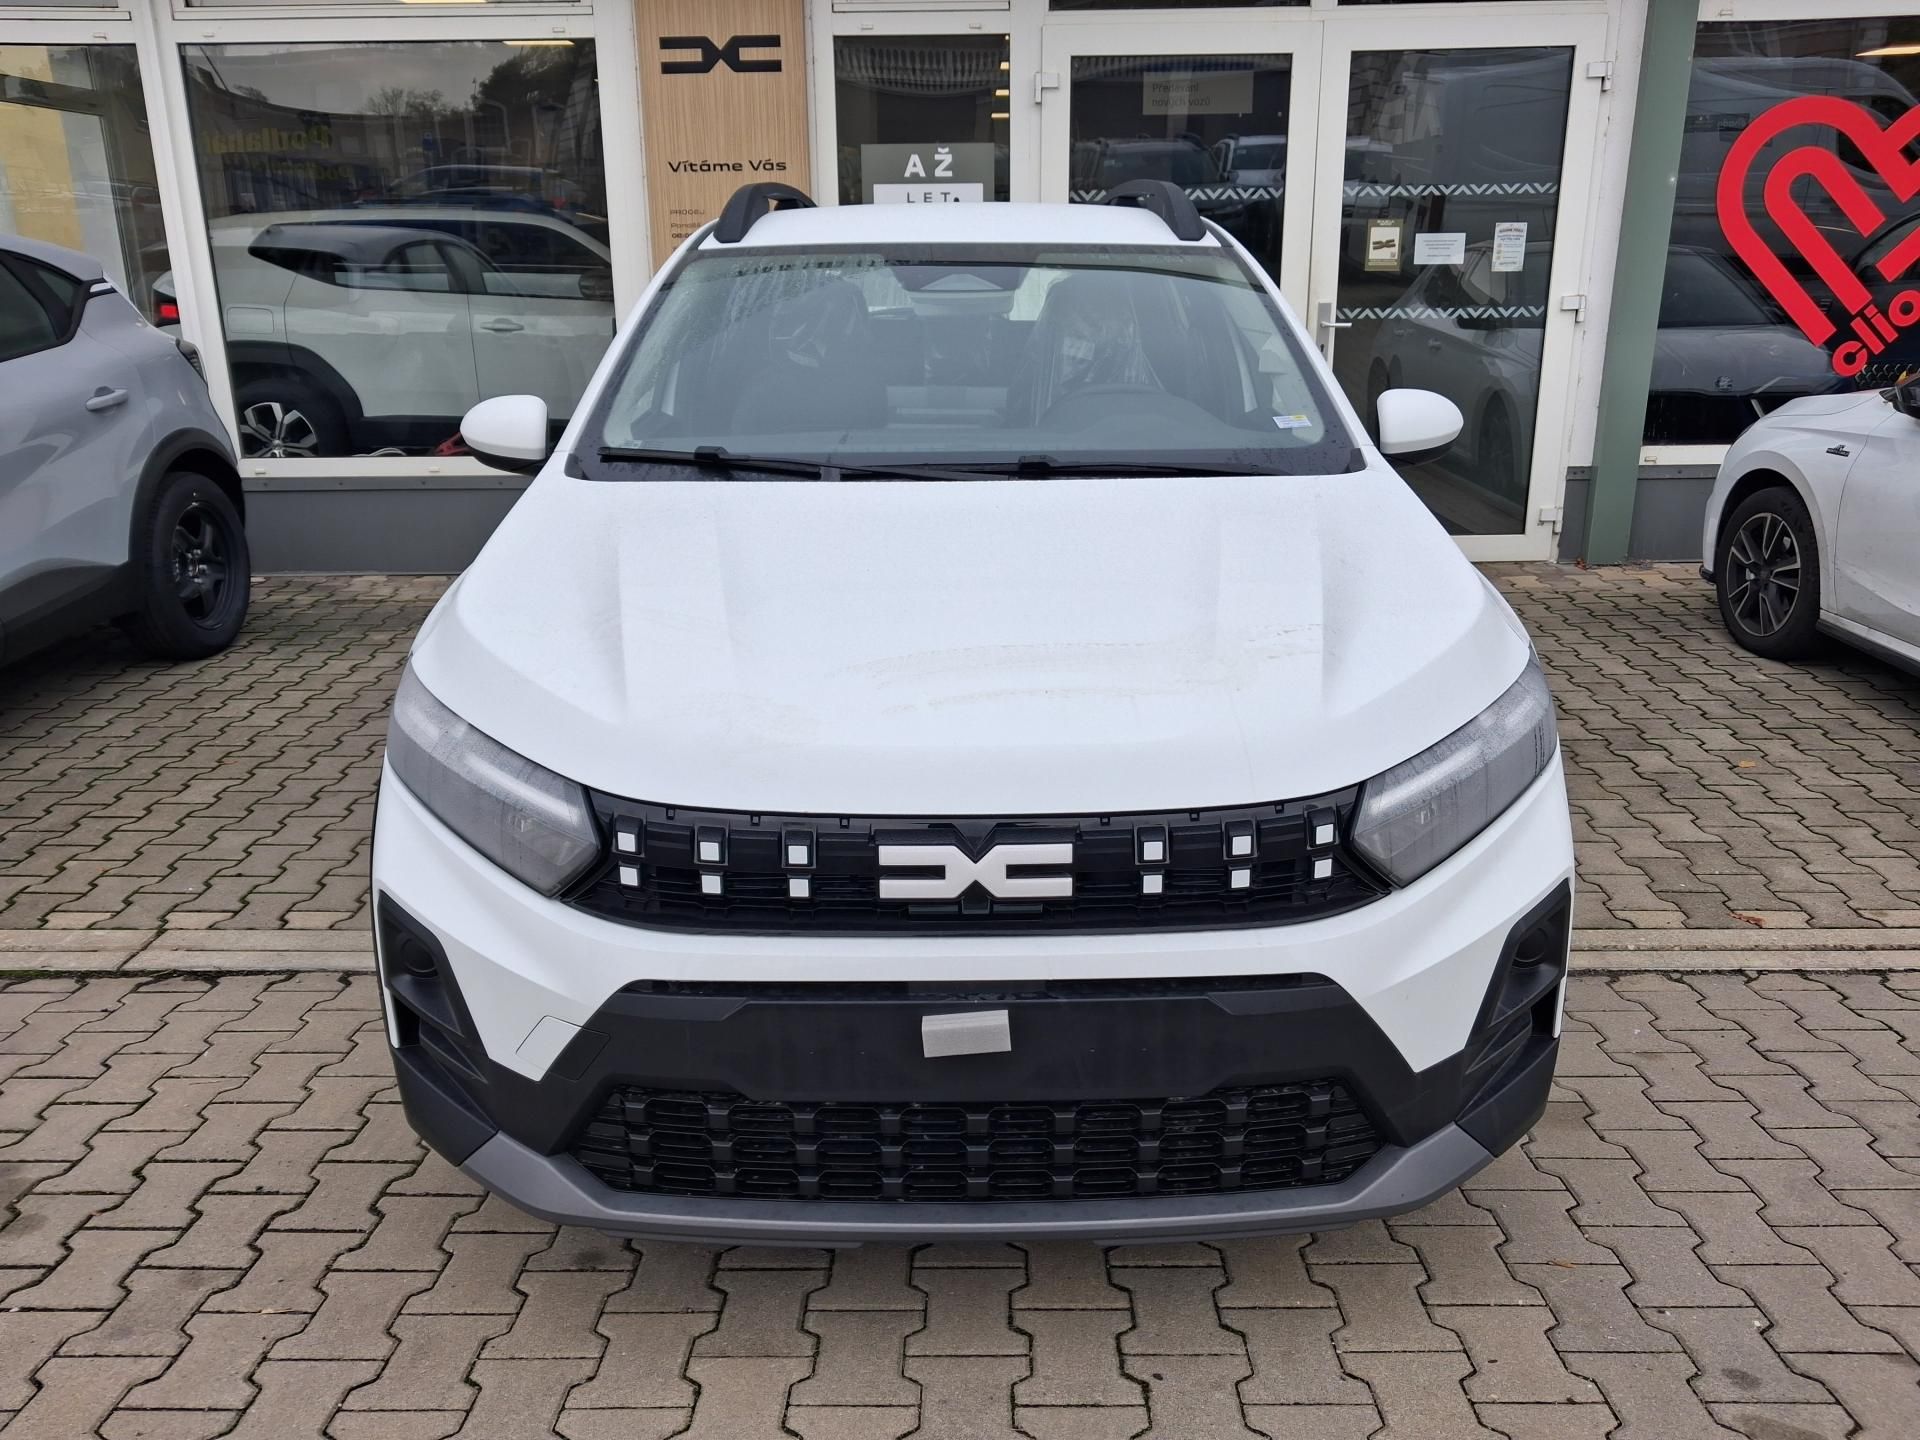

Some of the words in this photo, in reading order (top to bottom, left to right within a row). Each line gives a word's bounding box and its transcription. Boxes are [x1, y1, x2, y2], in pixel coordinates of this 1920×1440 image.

[668, 159, 743, 173] Vítáme
[748, 158, 787, 172] Vás
[1832, 289, 1920, 377] clio
